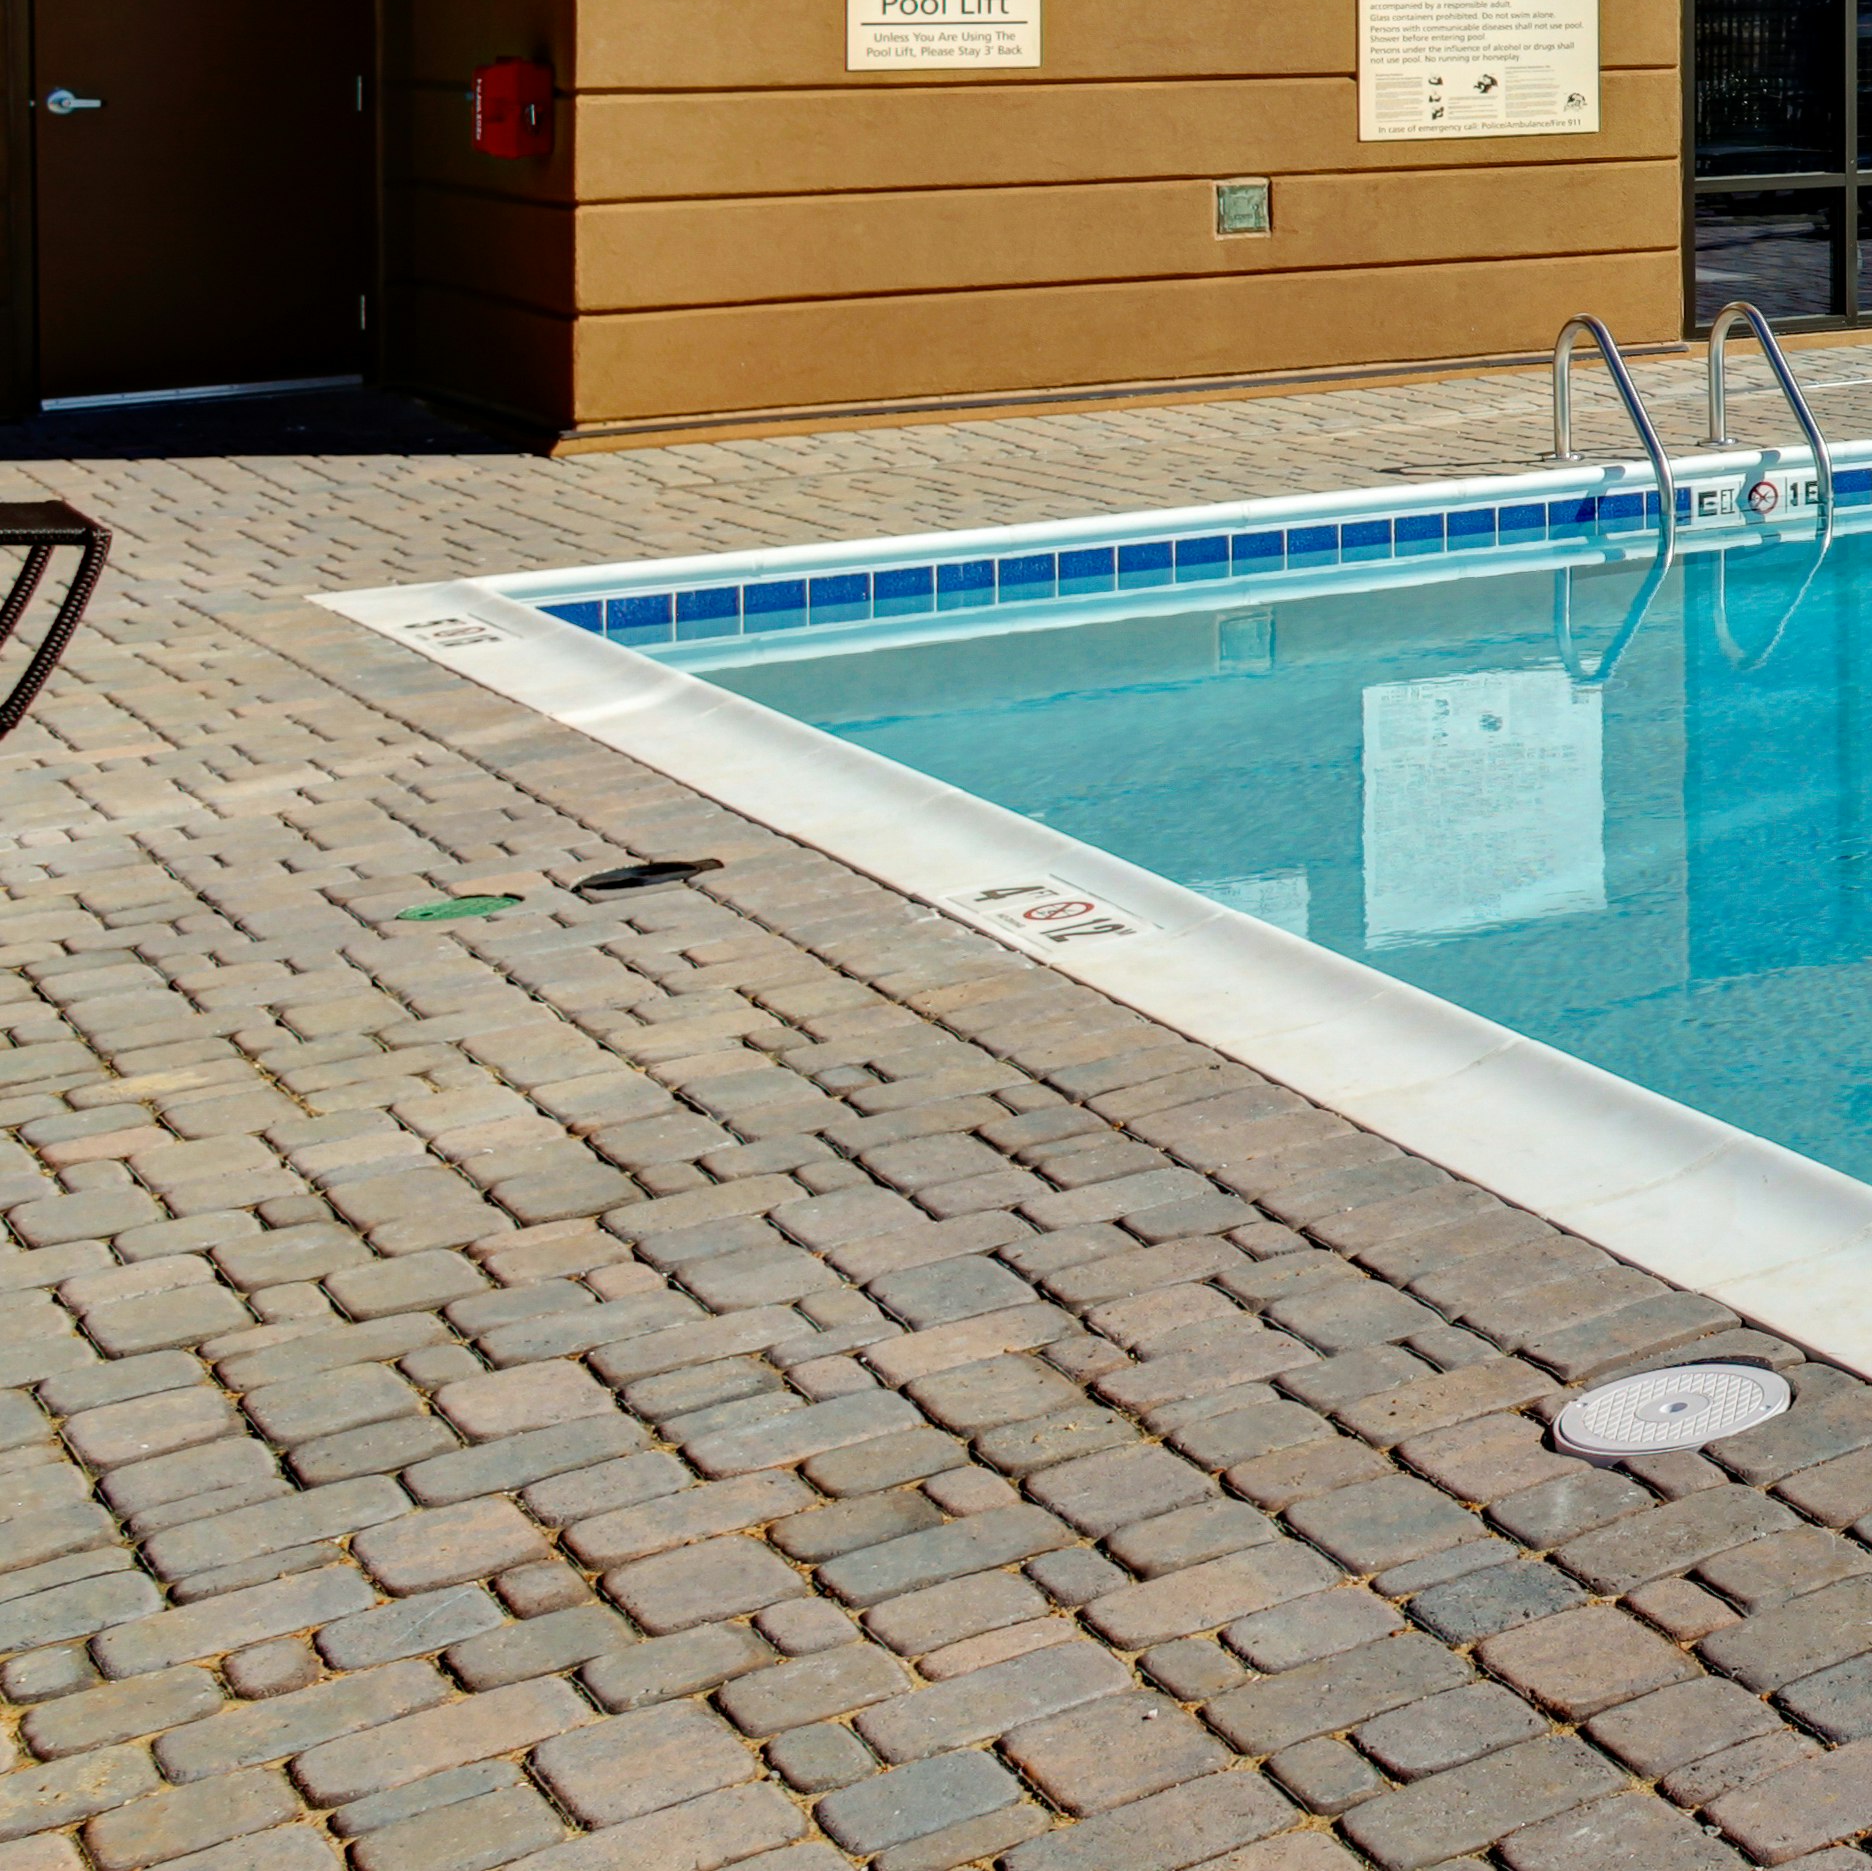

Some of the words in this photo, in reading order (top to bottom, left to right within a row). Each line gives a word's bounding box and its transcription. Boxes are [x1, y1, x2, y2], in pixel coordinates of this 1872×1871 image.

[1370, 2, 1422, 10] accompanied
[1425, 2, 1434, 10] by
[874, 32, 909, 43] Unless
[913, 32, 934, 42] You
[938, 32, 958, 41] Are
[962, 32, 992, 43] Using
[995, 31, 1016, 41] The
[1431, 34, 1465, 42] entering
[866, 47, 891, 57] Pool
[895, 47, 916, 57] Lift,
[921, 46, 954, 56] Please
[958, 46, 981, 57] Stay
[998, 45, 1022, 55] Back
[1534, 43, 1555, 51] drugs
